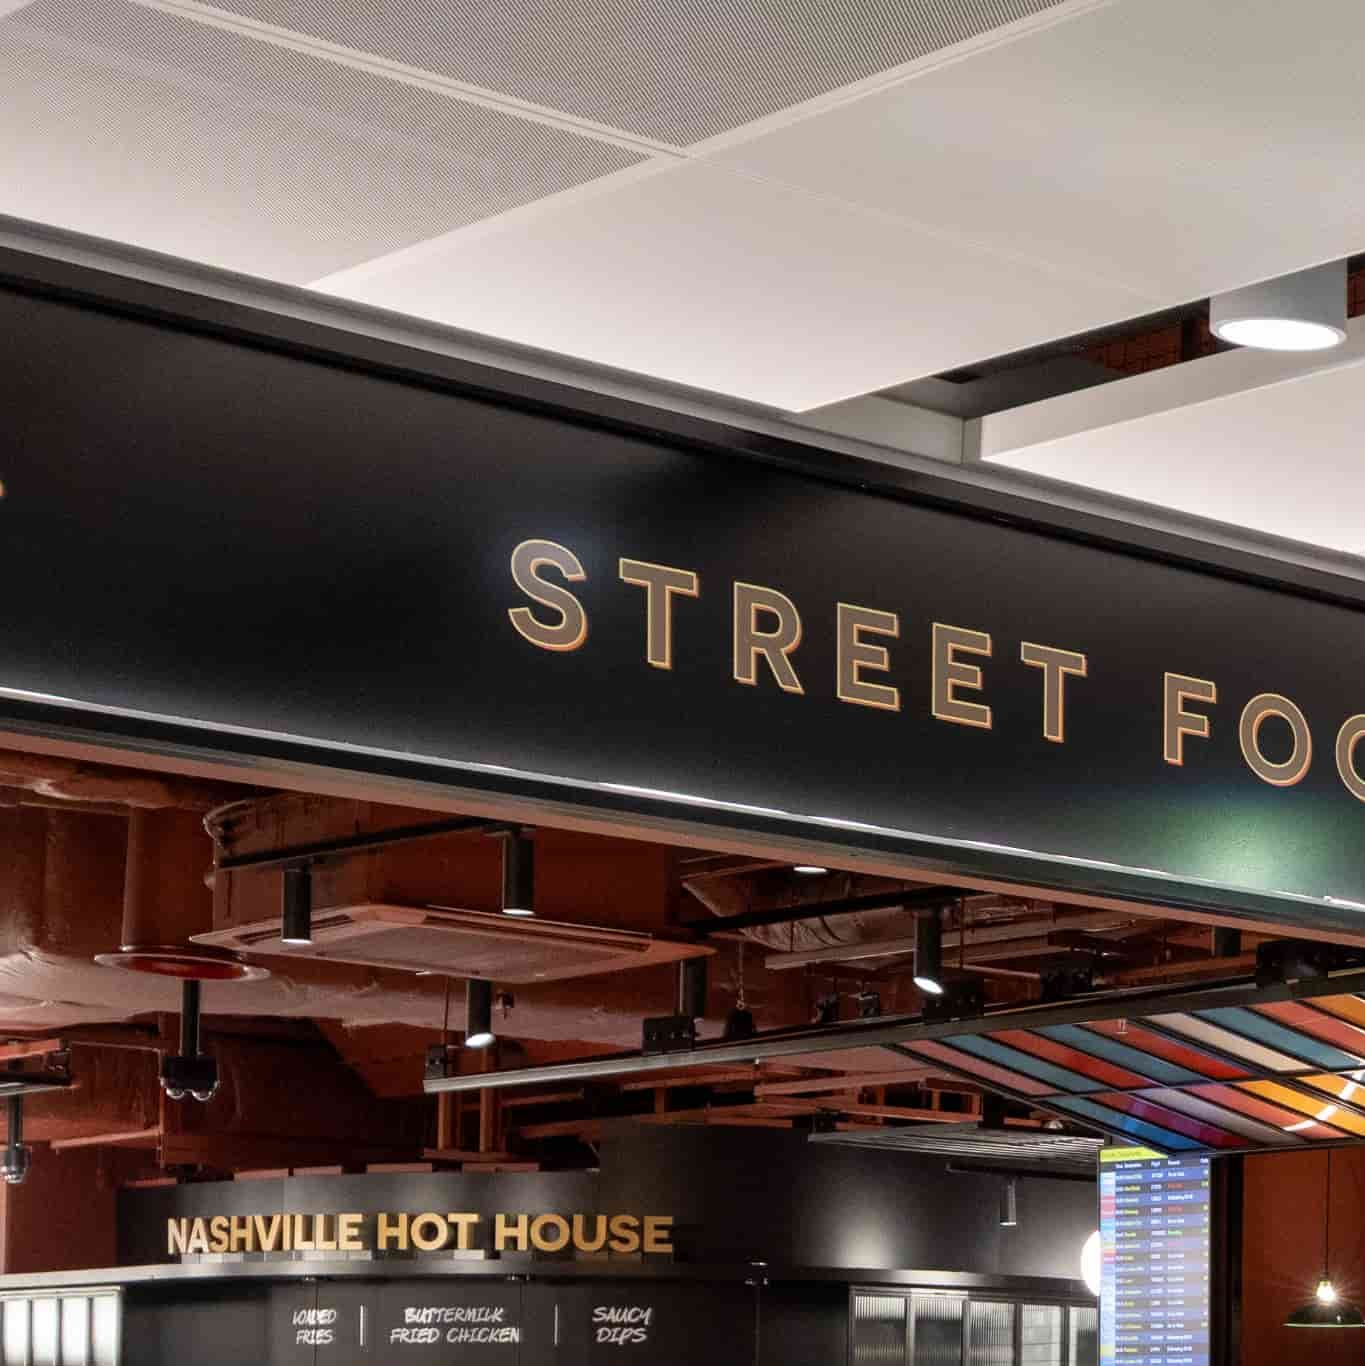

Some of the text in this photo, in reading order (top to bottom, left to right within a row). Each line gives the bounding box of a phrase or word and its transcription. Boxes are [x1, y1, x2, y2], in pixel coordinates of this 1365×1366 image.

[508, 538, 1088, 743] STREET
[167, 1213, 674, 1255] NASHVILLE HOT HOUSE
[292, 1308, 338, 1325] LOADED
[404, 1306, 505, 1324] BUTTERMILK
[592, 1306, 654, 1325] SAUCY
[294, 1328, 334, 1345] FRIES
[389, 1326, 521, 1344] FRIED CHICKEN
[596, 1327, 648, 1344] DIPS
